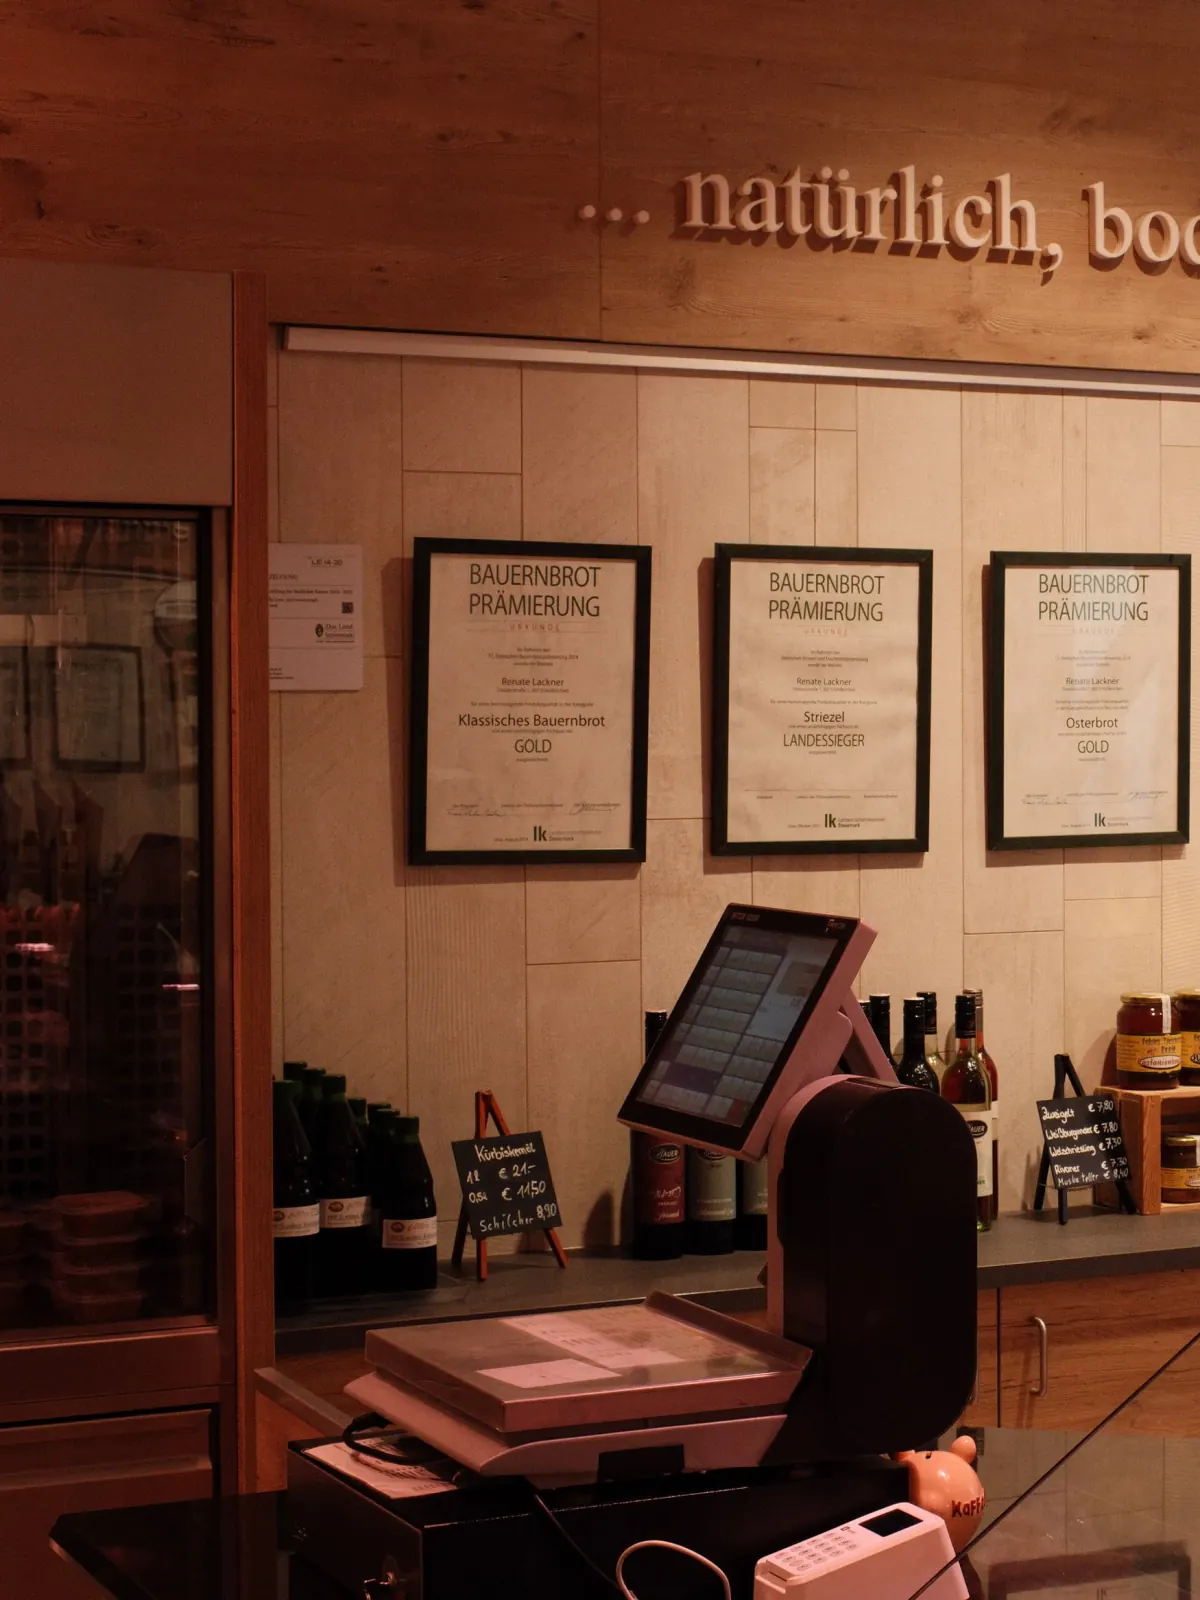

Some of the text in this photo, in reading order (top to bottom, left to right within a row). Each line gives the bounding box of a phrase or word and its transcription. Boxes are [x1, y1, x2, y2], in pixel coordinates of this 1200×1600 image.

[681, 163, 1063, 274] natürlich,
[469, 563, 601, 588] BAUERNBROT
[769, 571, 885, 595] BAUERNBROT
[1039, 573, 1150, 595] BAUERNBROT
[468, 589, 601, 618] PRÄMIERUNG
[768, 596, 884, 623] PRÄMIERUNG
[1038, 597, 1149, 622] PRÄMIERUNG
[501, 677, 564, 686] Renate Lackner
[796, 677, 852, 686] Renate Lackner
[1091, 677, 1120, 686] Lackner
[458, 714, 606, 727] Klassisches Bauernbrot
[803, 710, 845, 723] Striezel
[1065, 716, 1119, 729] Osterbrot
[514, 739, 552, 753] GOLD
[783, 733, 866, 748] LANDESSIEGER
[1077, 740, 1110, 753] GOLD
[1041, 1106, 1075, 1124] Zweigelt
[474, 1142, 536, 1162] Kürbiskernöl
[498, 1167, 508, 1179] €
[1054, 1163, 1080, 1175] Rivaner
[501, 1187, 513, 1201] €
[516, 1180, 546, 1199] 11,50
[479, 1209, 534, 1232] Schilcher
